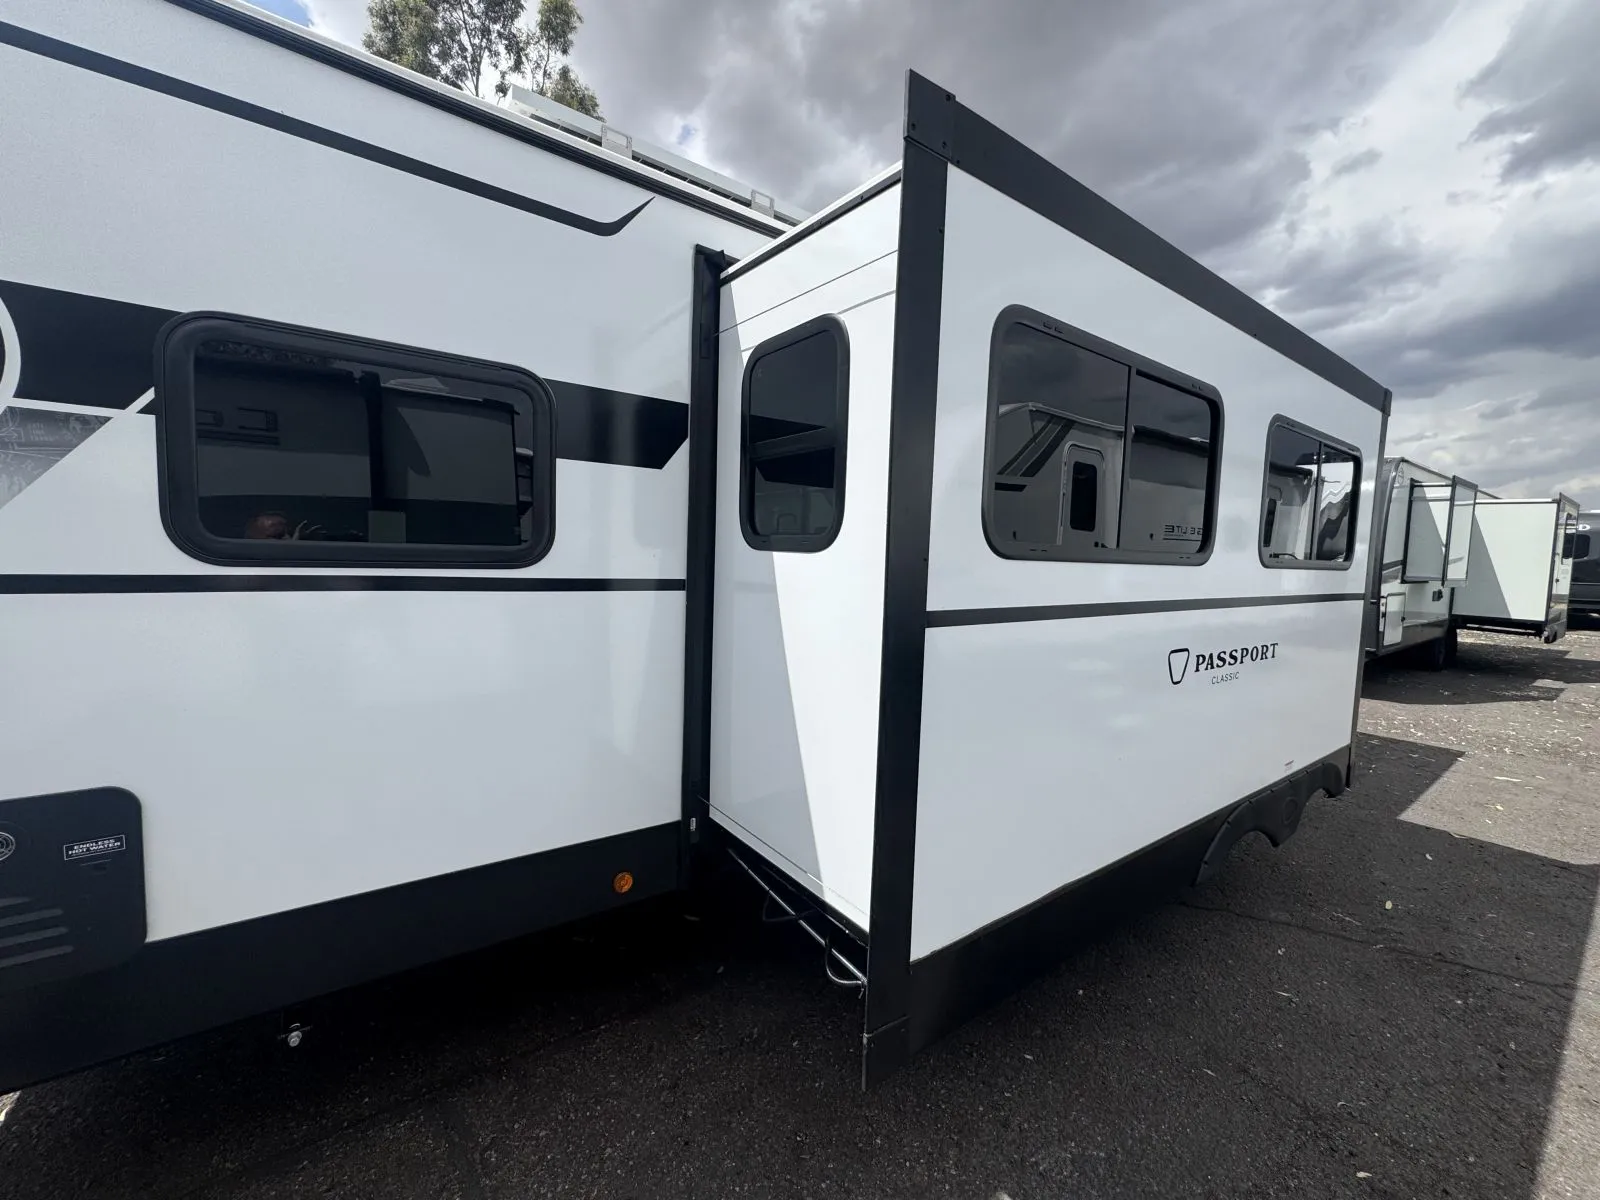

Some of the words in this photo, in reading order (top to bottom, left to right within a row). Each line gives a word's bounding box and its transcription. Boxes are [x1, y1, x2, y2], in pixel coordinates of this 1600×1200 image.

[1194, 643, 1279, 672] PASSPORT
[1211, 671, 1240, 685] CLASSIC
[68, 847, 88, 855] HOT
[89, 841, 121, 851] WATER
[73, 839, 116, 850] ENDLESS
